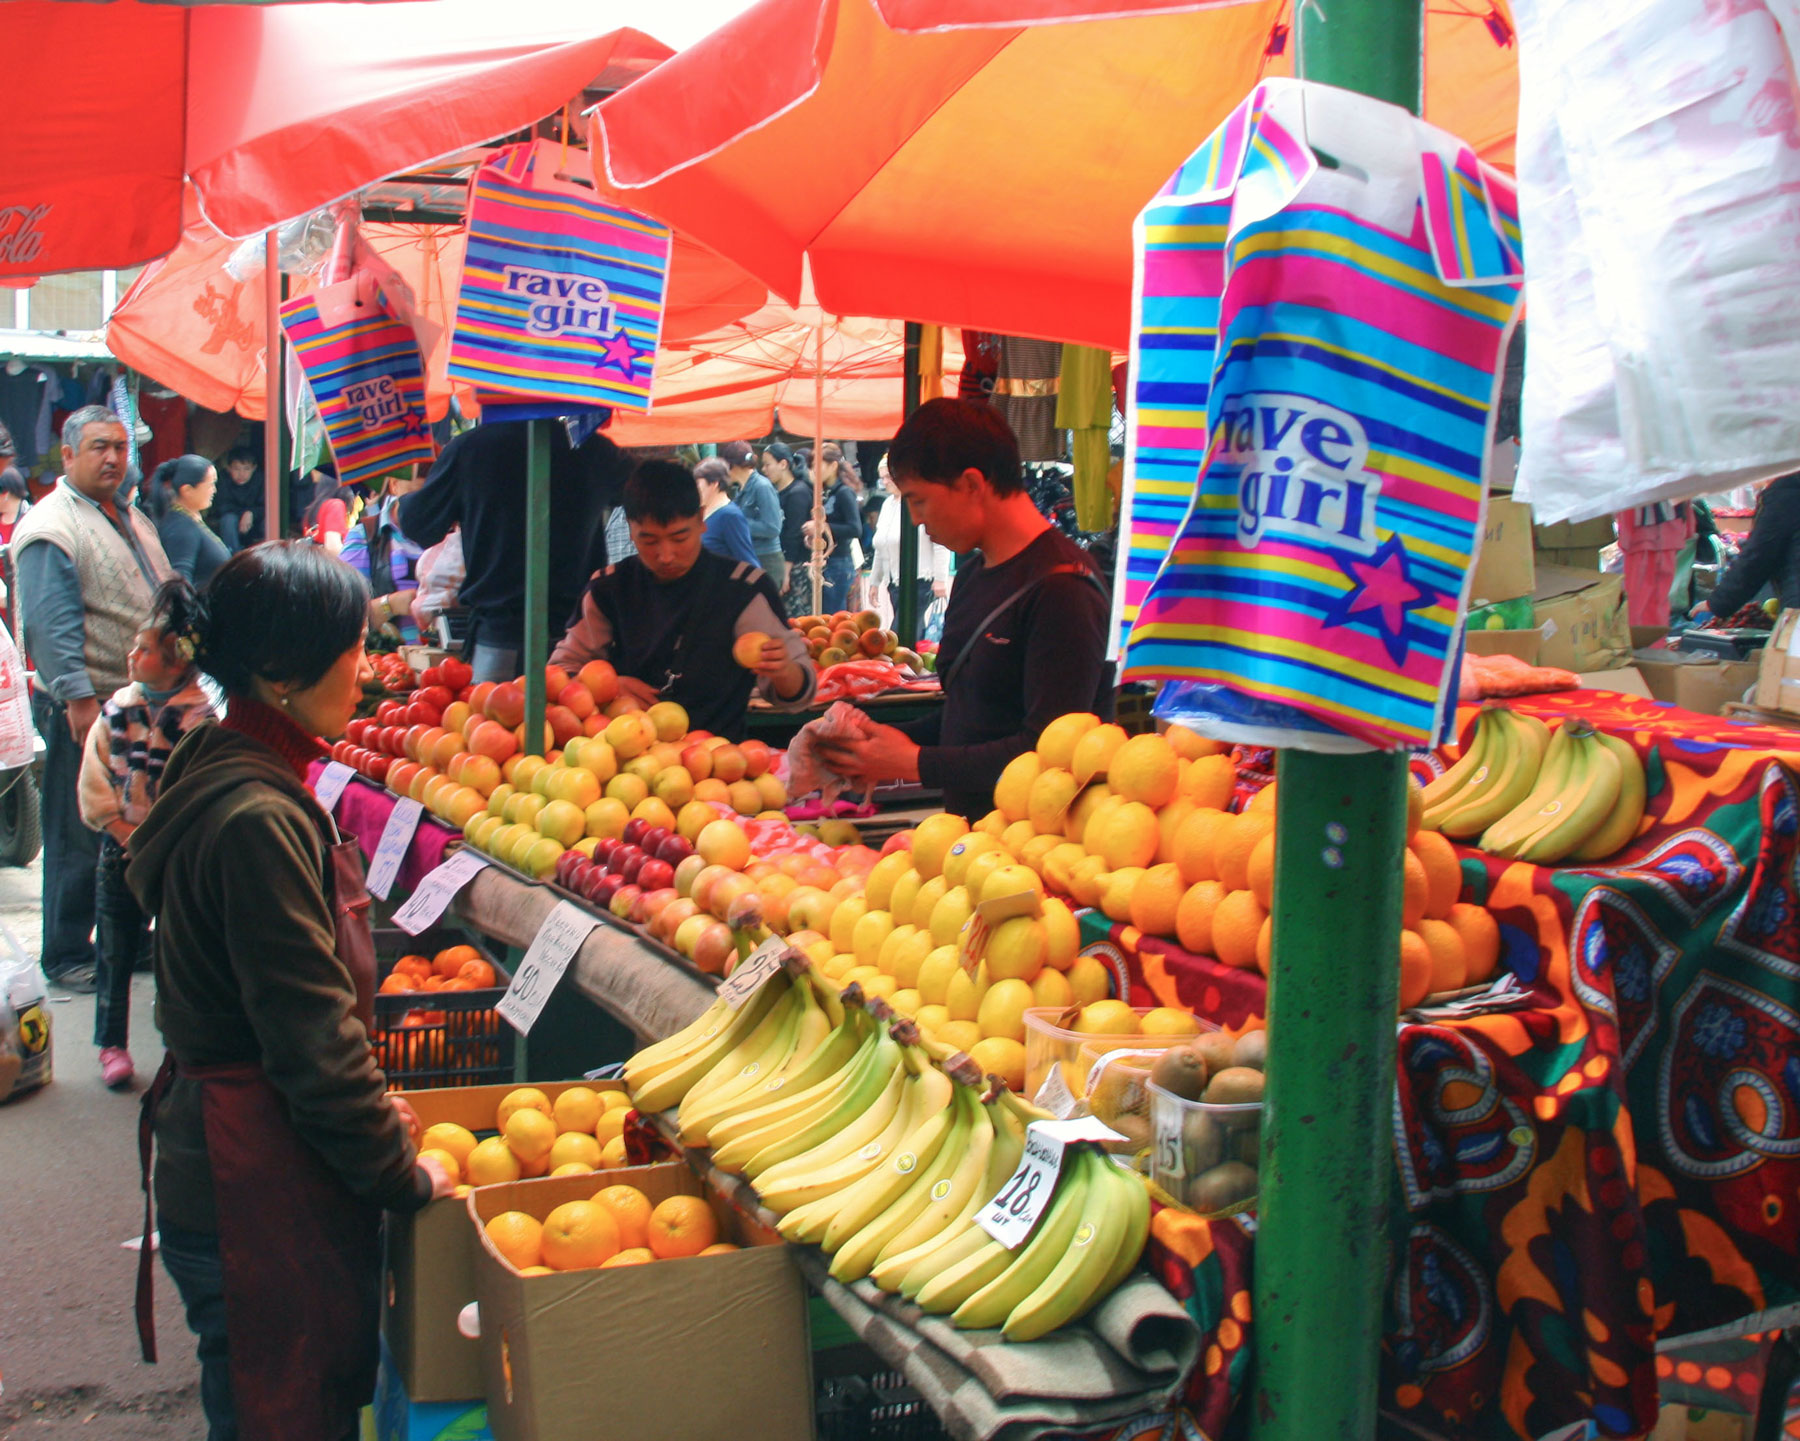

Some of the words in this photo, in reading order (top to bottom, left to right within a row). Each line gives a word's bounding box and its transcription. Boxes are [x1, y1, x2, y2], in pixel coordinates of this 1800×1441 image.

[507, 271, 603, 303] rave
[531, 299, 611, 333] girl
[346, 378, 394, 405] rave
[362, 391, 403, 427] girl
[1220, 405, 1354, 471] rave
[1239, 455, 1368, 543] girl
[512, 964, 540, 1001] 90
[994, 1163, 1042, 1216] 18
